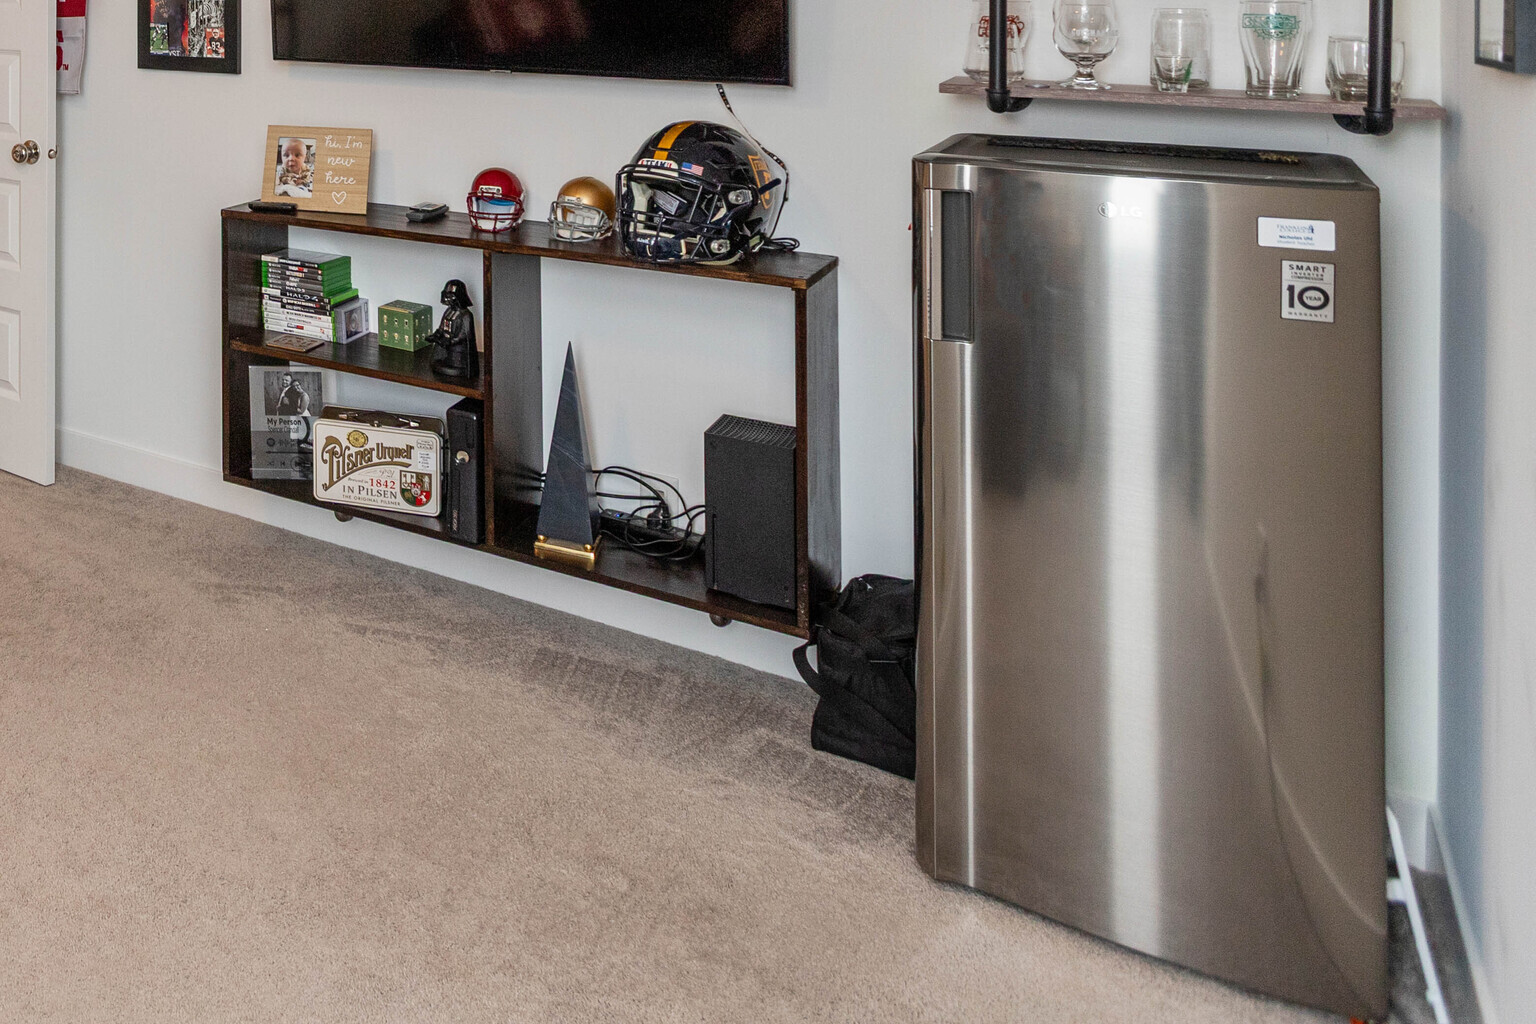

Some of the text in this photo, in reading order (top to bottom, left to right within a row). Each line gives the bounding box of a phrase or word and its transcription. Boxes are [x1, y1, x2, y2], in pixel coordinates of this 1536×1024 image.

[211, 41, 221, 51] 83
[344, 136, 363, 149] I'm
[327, 156, 356, 167] new
[325, 171, 356, 185] here
[1289, 263, 1326, 274] SMART
[286, 291, 310, 300] HALO
[1286, 284, 1330, 311] 10
[267, 418, 302, 427] My Person
[321, 435, 376, 492] Pilsner
[375, 442, 415, 462] Urquell
[369, 478, 396, 490] 1842
[342, 484, 398, 500] IN PILSEN
[353, 495, 379, 504] ORIGINAL
[380, 499, 401, 507] PILSNER
